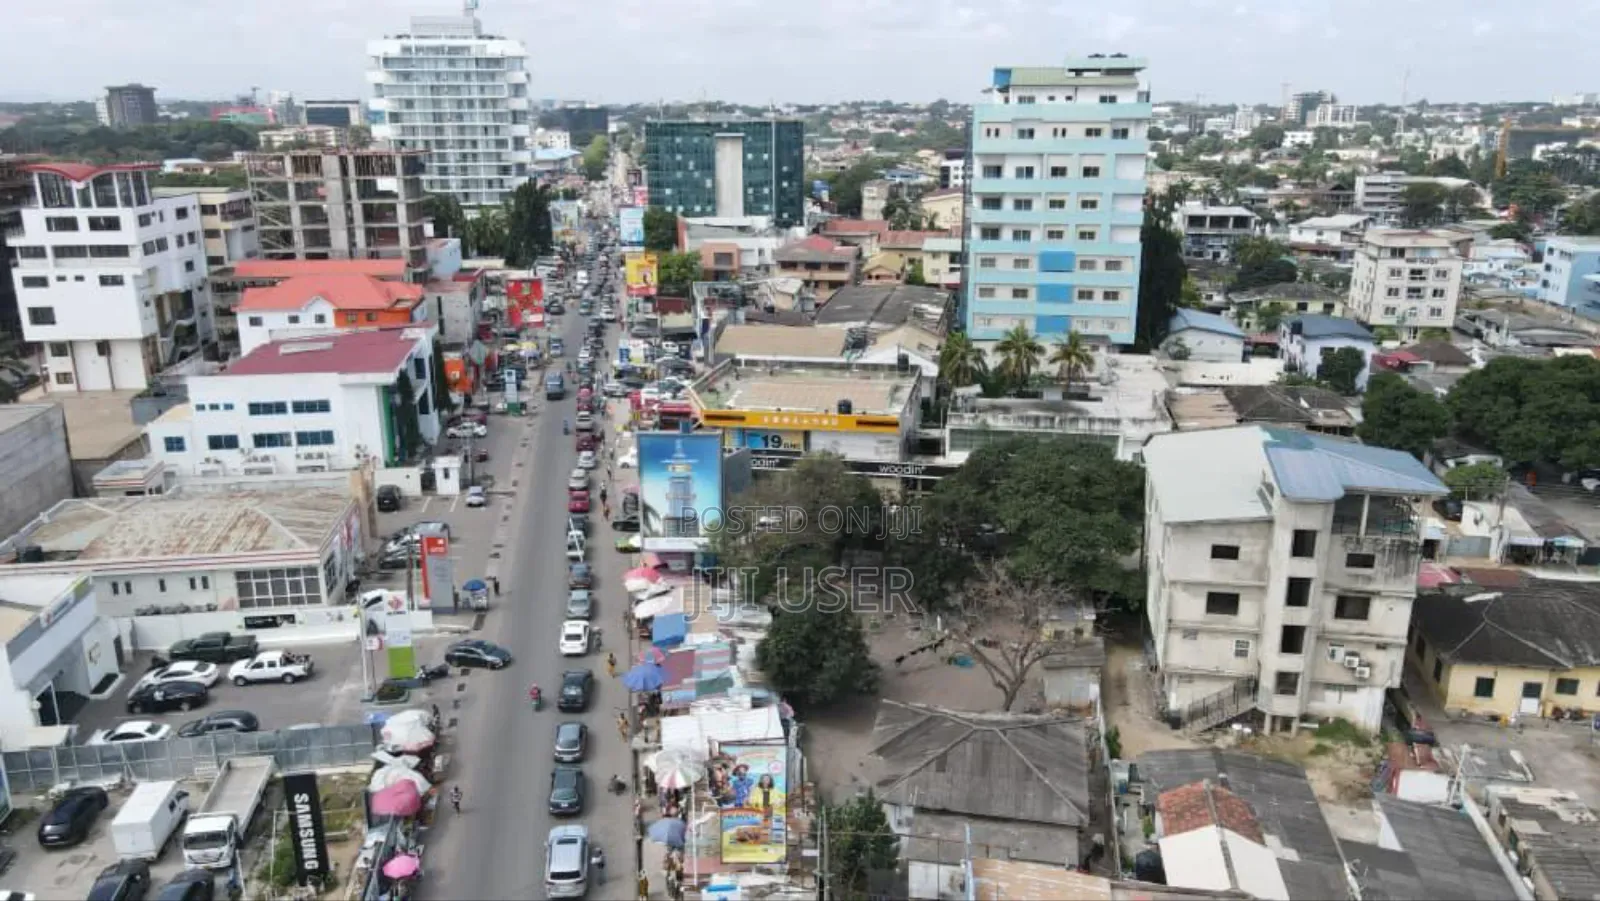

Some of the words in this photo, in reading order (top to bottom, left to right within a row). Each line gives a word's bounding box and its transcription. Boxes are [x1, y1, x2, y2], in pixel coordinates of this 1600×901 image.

[761, 434, 783, 448] 19
[879, 464, 923, 475] woodin
[293, 793, 319, 870] SAMSUNG
